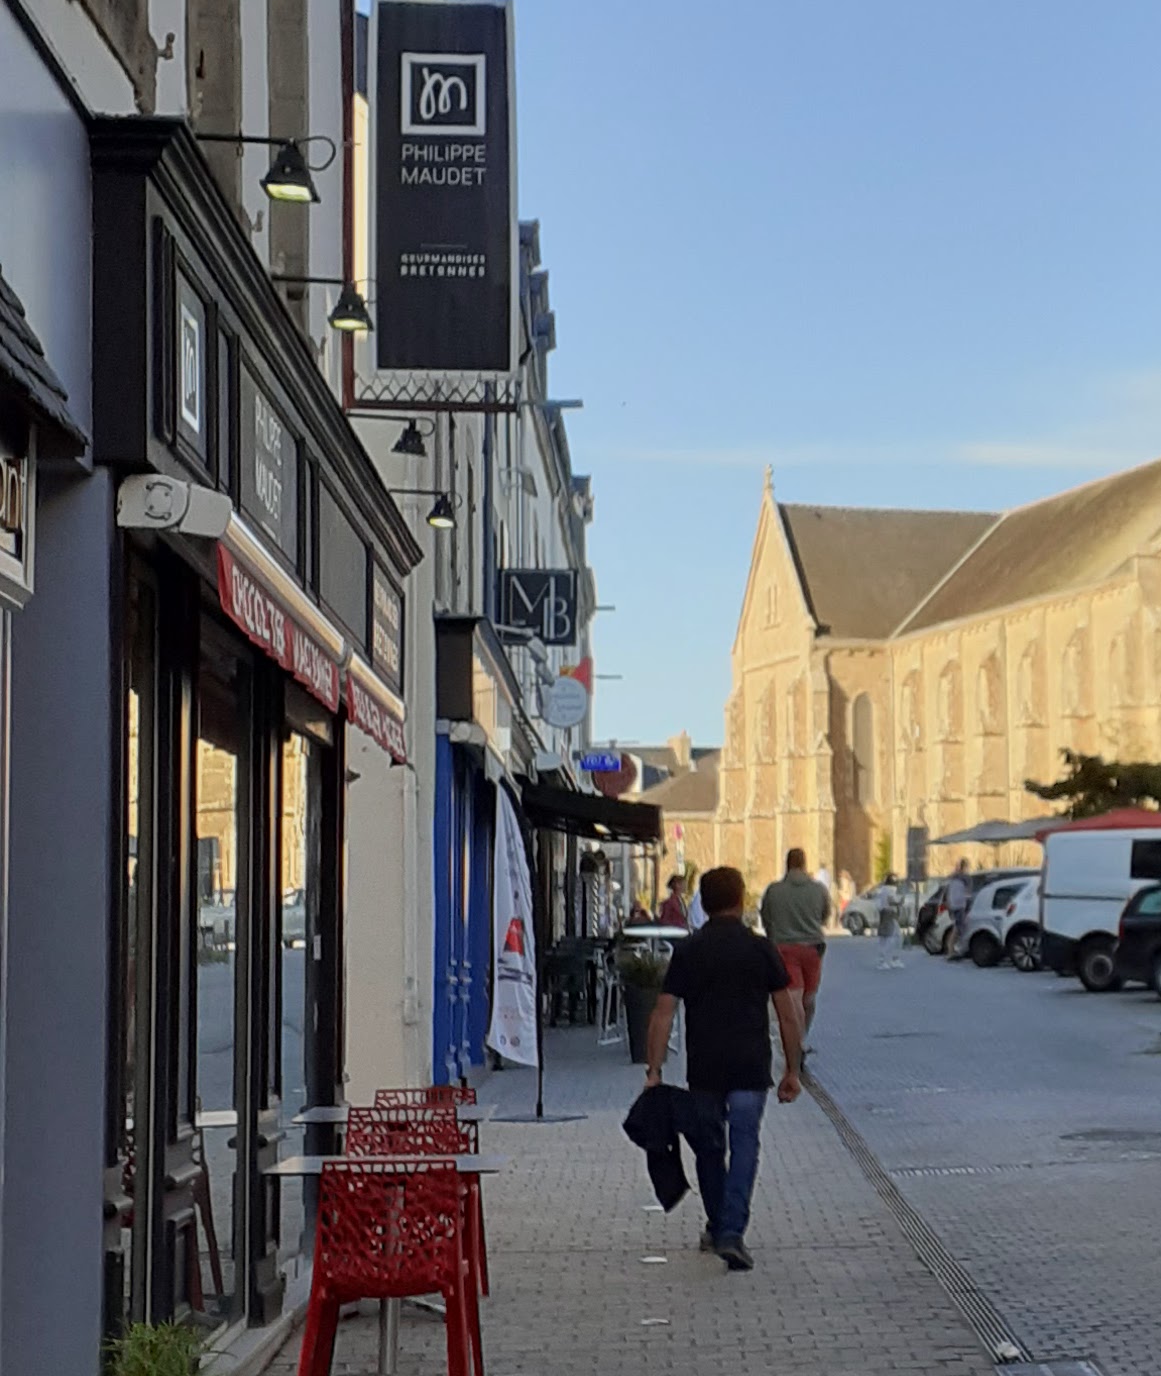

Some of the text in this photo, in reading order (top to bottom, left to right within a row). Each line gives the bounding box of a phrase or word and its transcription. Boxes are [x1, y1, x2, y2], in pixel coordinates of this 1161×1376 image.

[401, 143, 486, 162] PHILIPPE
[401, 167, 487, 186] MAUDET
[400, 265, 486, 277] BRETONNES
